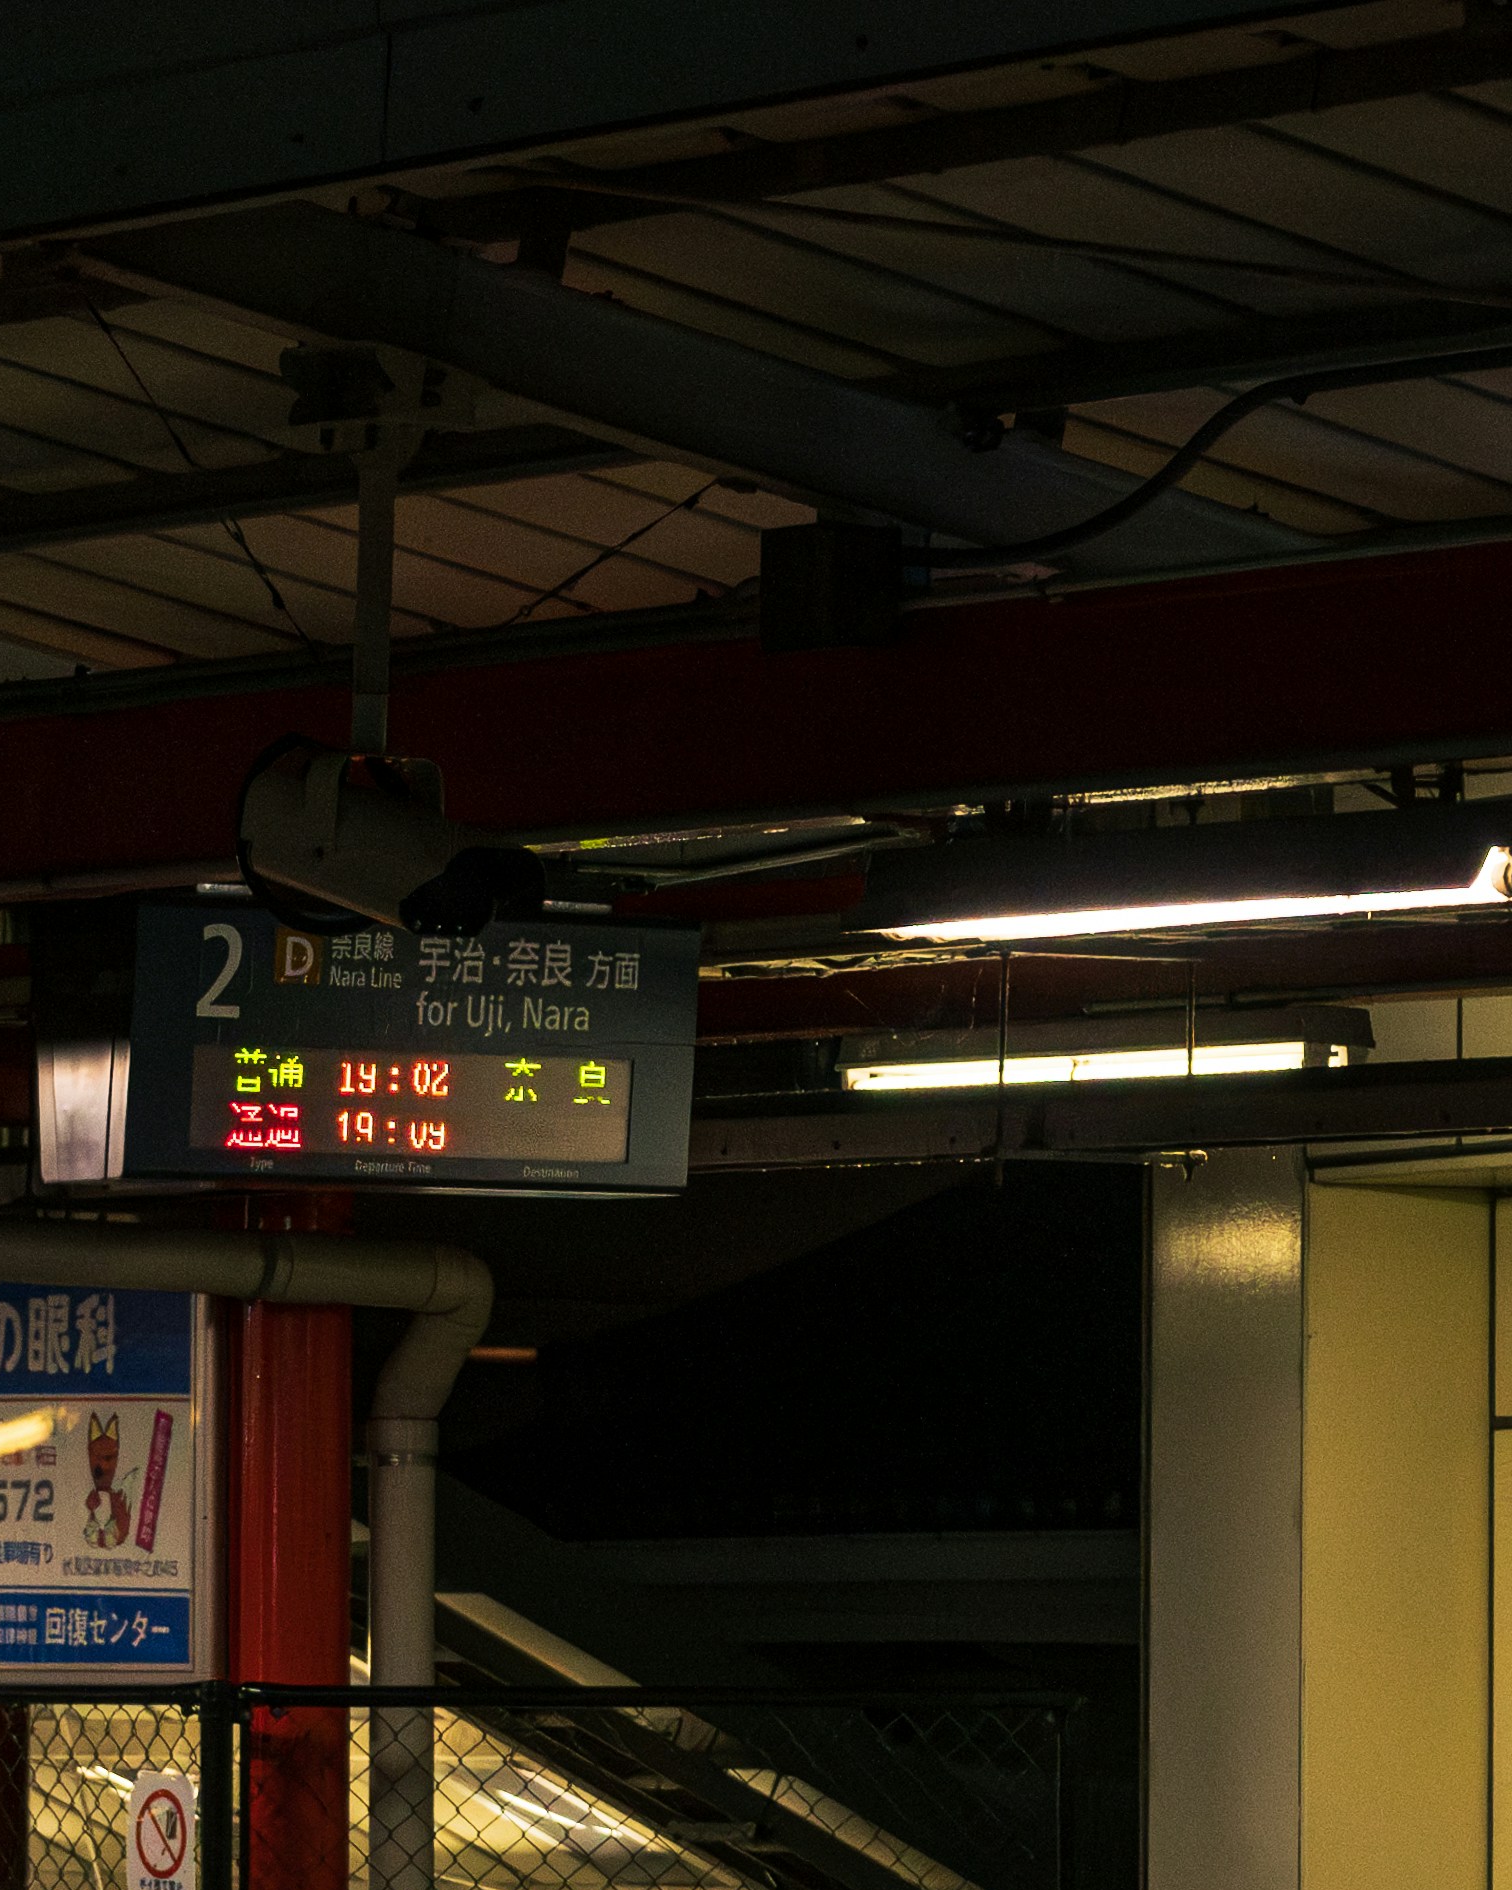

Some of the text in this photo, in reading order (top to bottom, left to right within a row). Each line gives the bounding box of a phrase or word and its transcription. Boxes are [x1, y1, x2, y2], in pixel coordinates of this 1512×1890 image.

[287, 936, 314, 978] D
[331, 933, 394, 960] 奈良線
[196, 924, 242, 1018] 2
[329, 965, 402, 989] Nara Line
[587, 951, 640, 991] 方面
[416, 996, 589, 1034] for Uji, Nara
[45, 1607, 170, 1648] 回復センター
